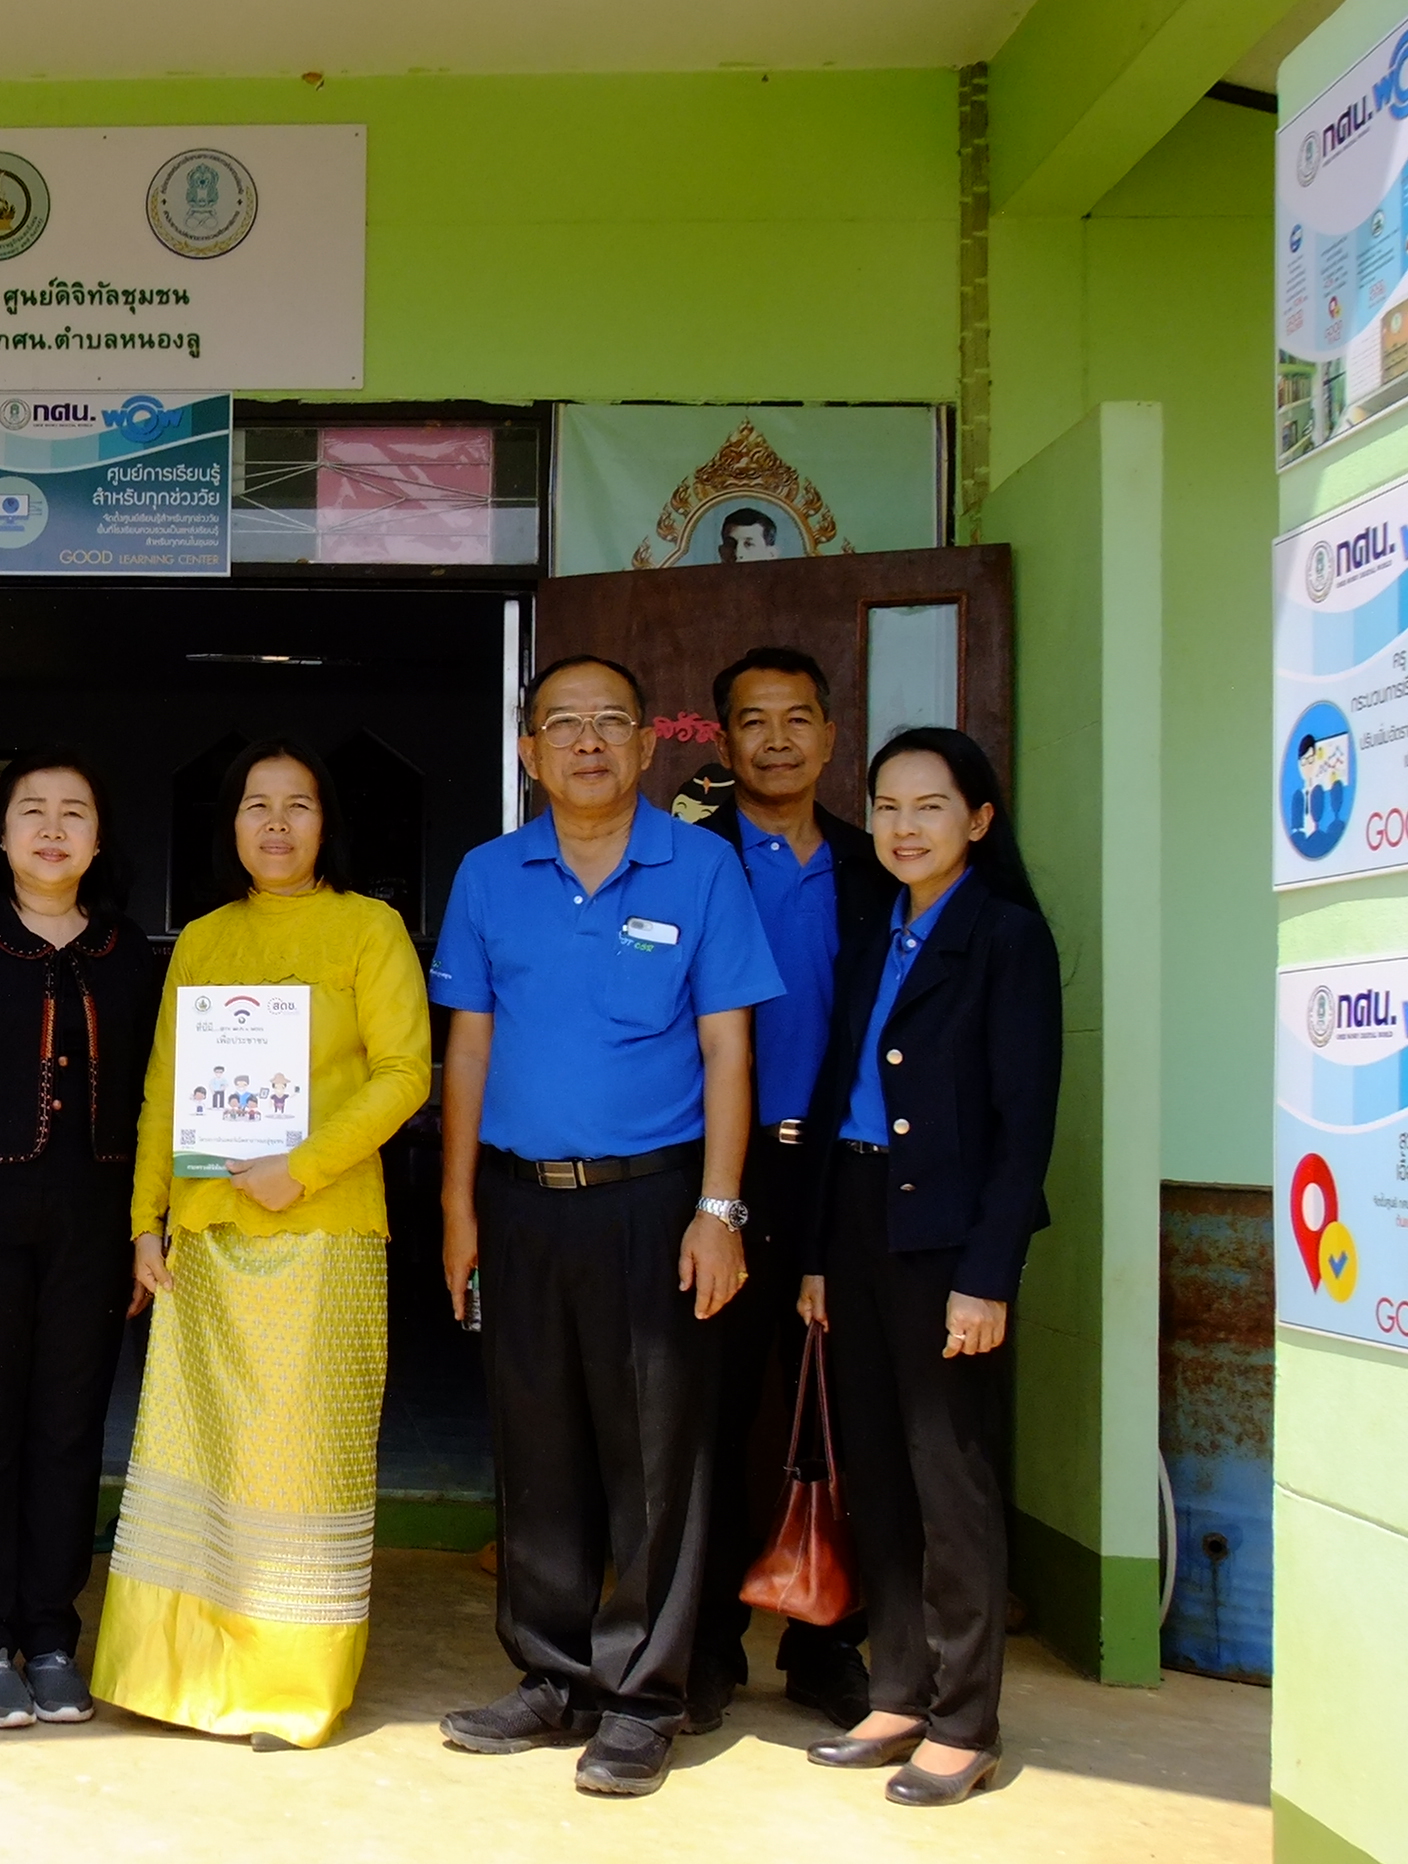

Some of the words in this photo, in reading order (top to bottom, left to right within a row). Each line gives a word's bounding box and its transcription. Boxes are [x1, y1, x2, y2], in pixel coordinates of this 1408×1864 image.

[1323, 95, 1373, 157] กศน.
[3, 277, 190, 314] ศูนย์ดิจิทัลชุมชน
[33, 403, 96, 421] กศน.
[101, 395, 184, 444] WOW
[107, 463, 220, 486] ศูนย์การเรียนรู้
[92, 487, 220, 511] สำหรับทุกช่วงวัย
[59, 549, 113, 565] GOOD
[119, 554, 174, 565] LEARNING
[178, 554, 220, 565] CENTER
[1336, 521, 1395, 577] กศน.
[1366, 808, 1408, 851] GO
[1337, 989, 1396, 1028] กศน.
